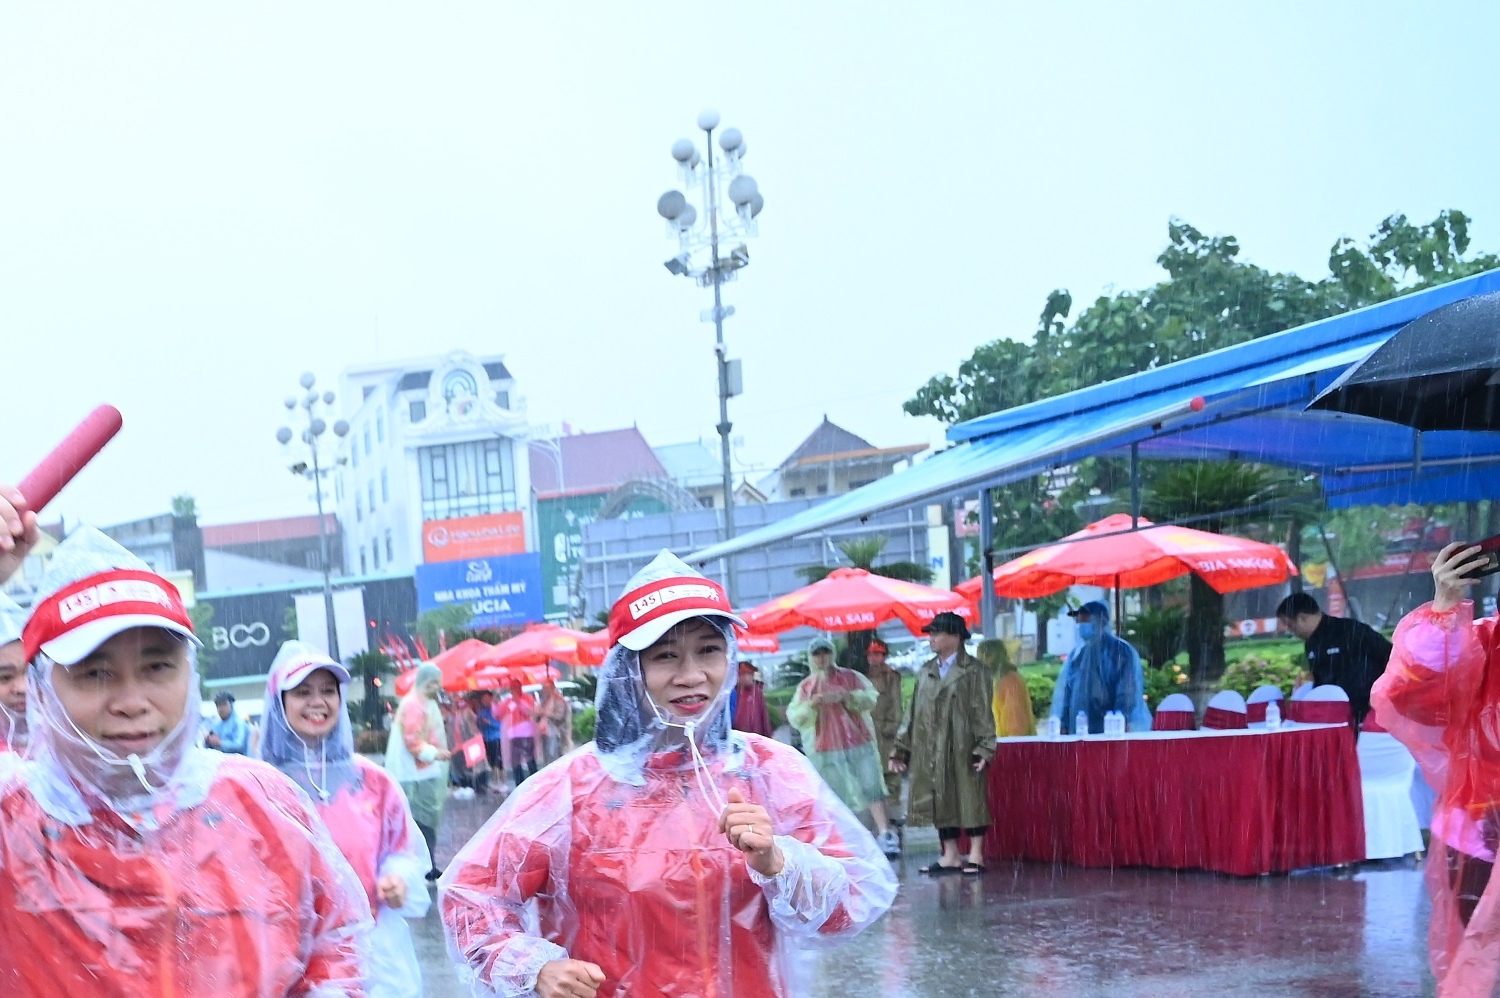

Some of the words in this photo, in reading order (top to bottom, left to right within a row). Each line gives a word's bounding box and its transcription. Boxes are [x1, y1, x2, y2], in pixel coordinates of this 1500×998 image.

[471, 598, 512, 615] UCIA
[633, 594, 657, 613] 145
[937, 606, 971, 618] SON
